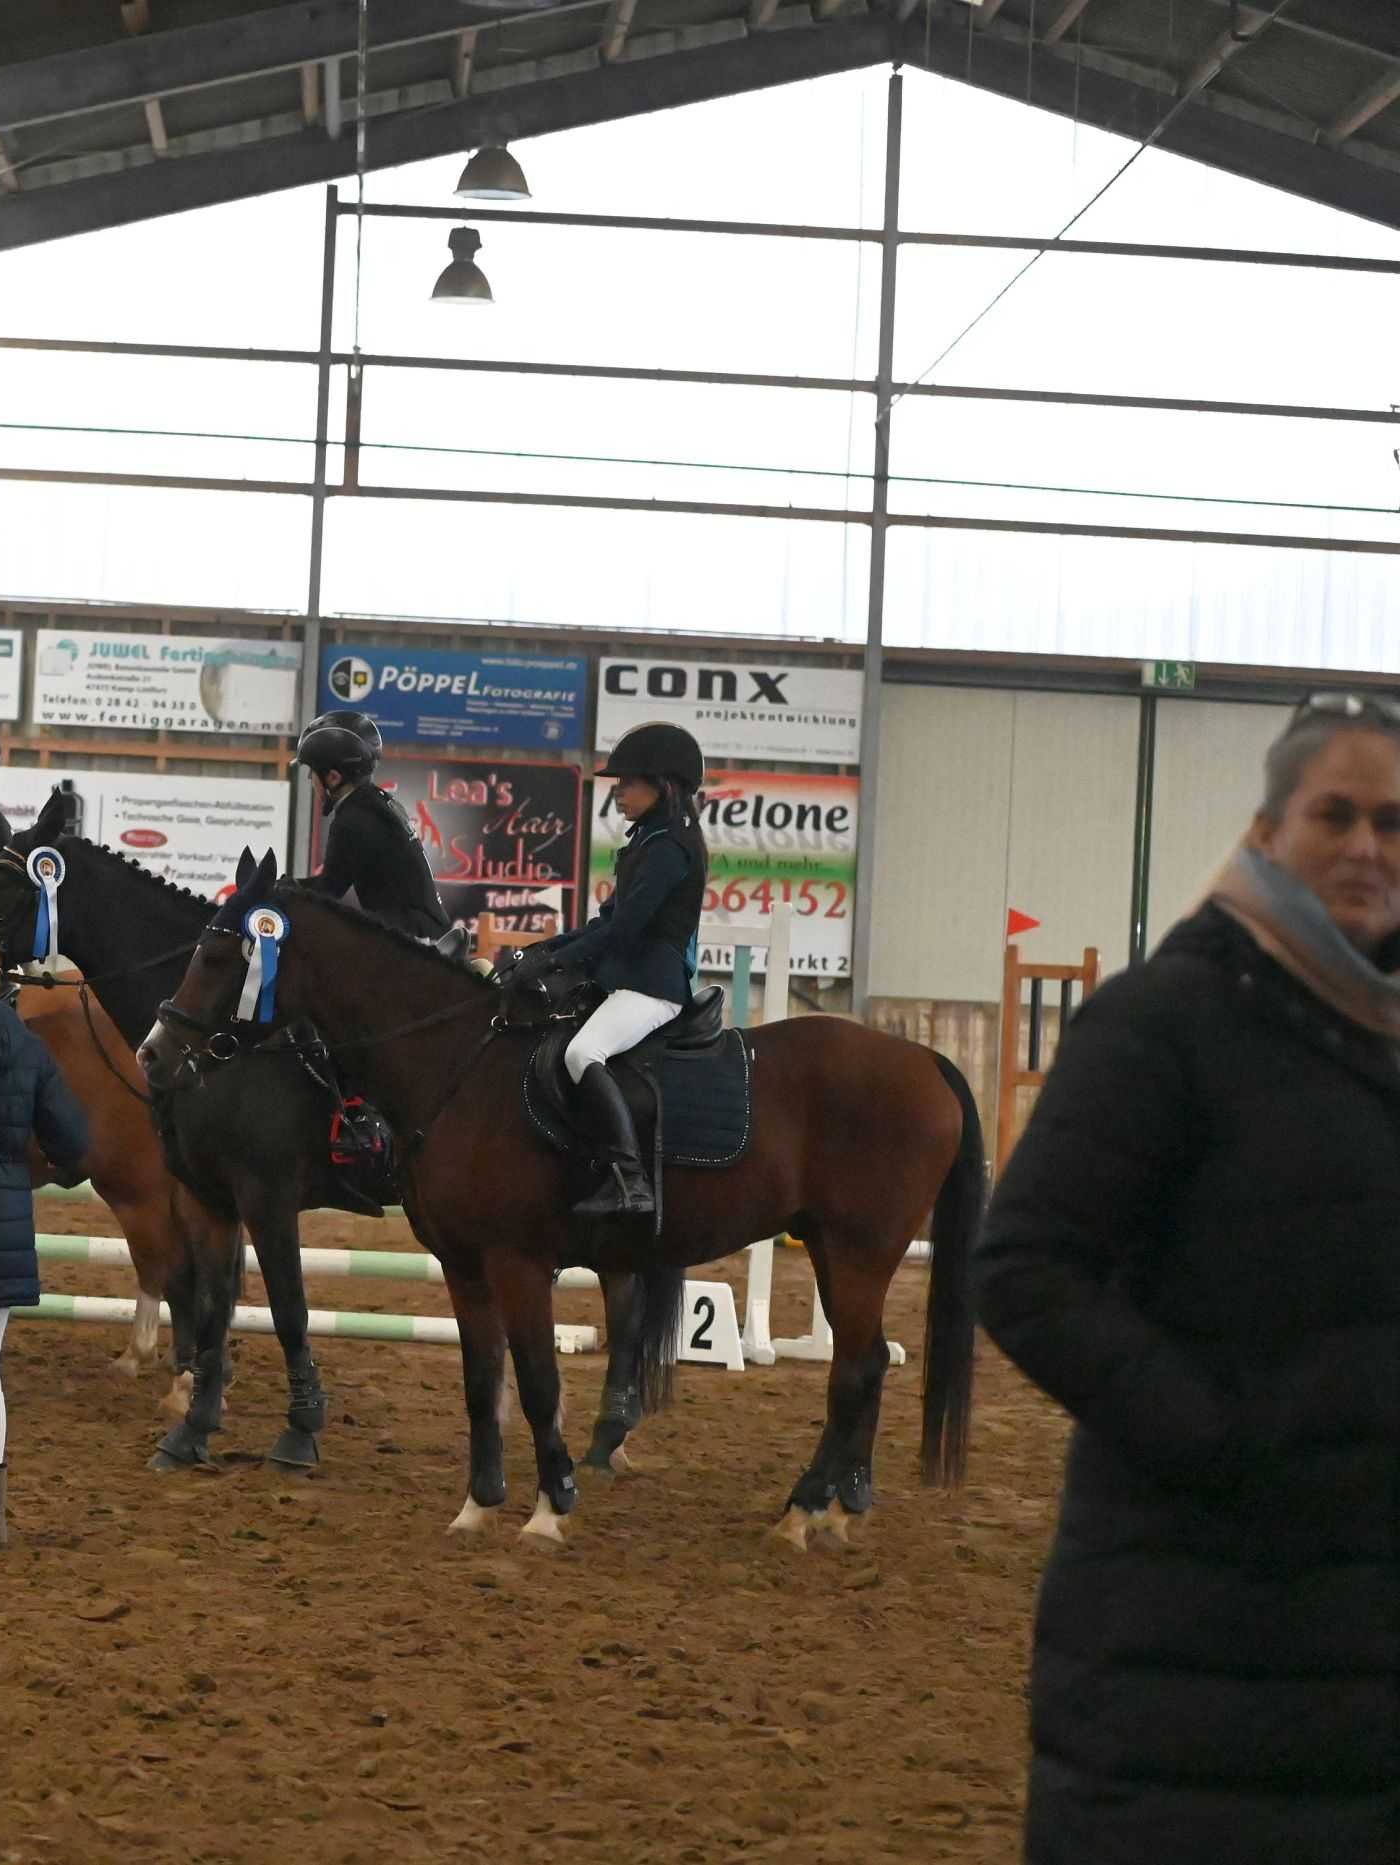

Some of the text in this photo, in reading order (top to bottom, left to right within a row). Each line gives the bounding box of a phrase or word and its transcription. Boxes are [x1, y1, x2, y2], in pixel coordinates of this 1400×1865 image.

[88, 642, 150, 660] JUWEL
[378, 664, 481, 696] PÖPPEL
[604, 664, 789, 704] conx
[42, 693, 89, 706] Telefon:
[481, 684, 576, 702] FOTOGRAFIE
[41, 709, 296, 734] www.fertiggaragen.net
[696, 709, 857, 729] projektentwicklung
[428, 769, 513, 806] Lea's
[450, 834, 561, 880] Studio
[486, 888, 538, 908] Telefo
[837, 956, 848, 972] 2
[690, 1296, 716, 1350] 2
